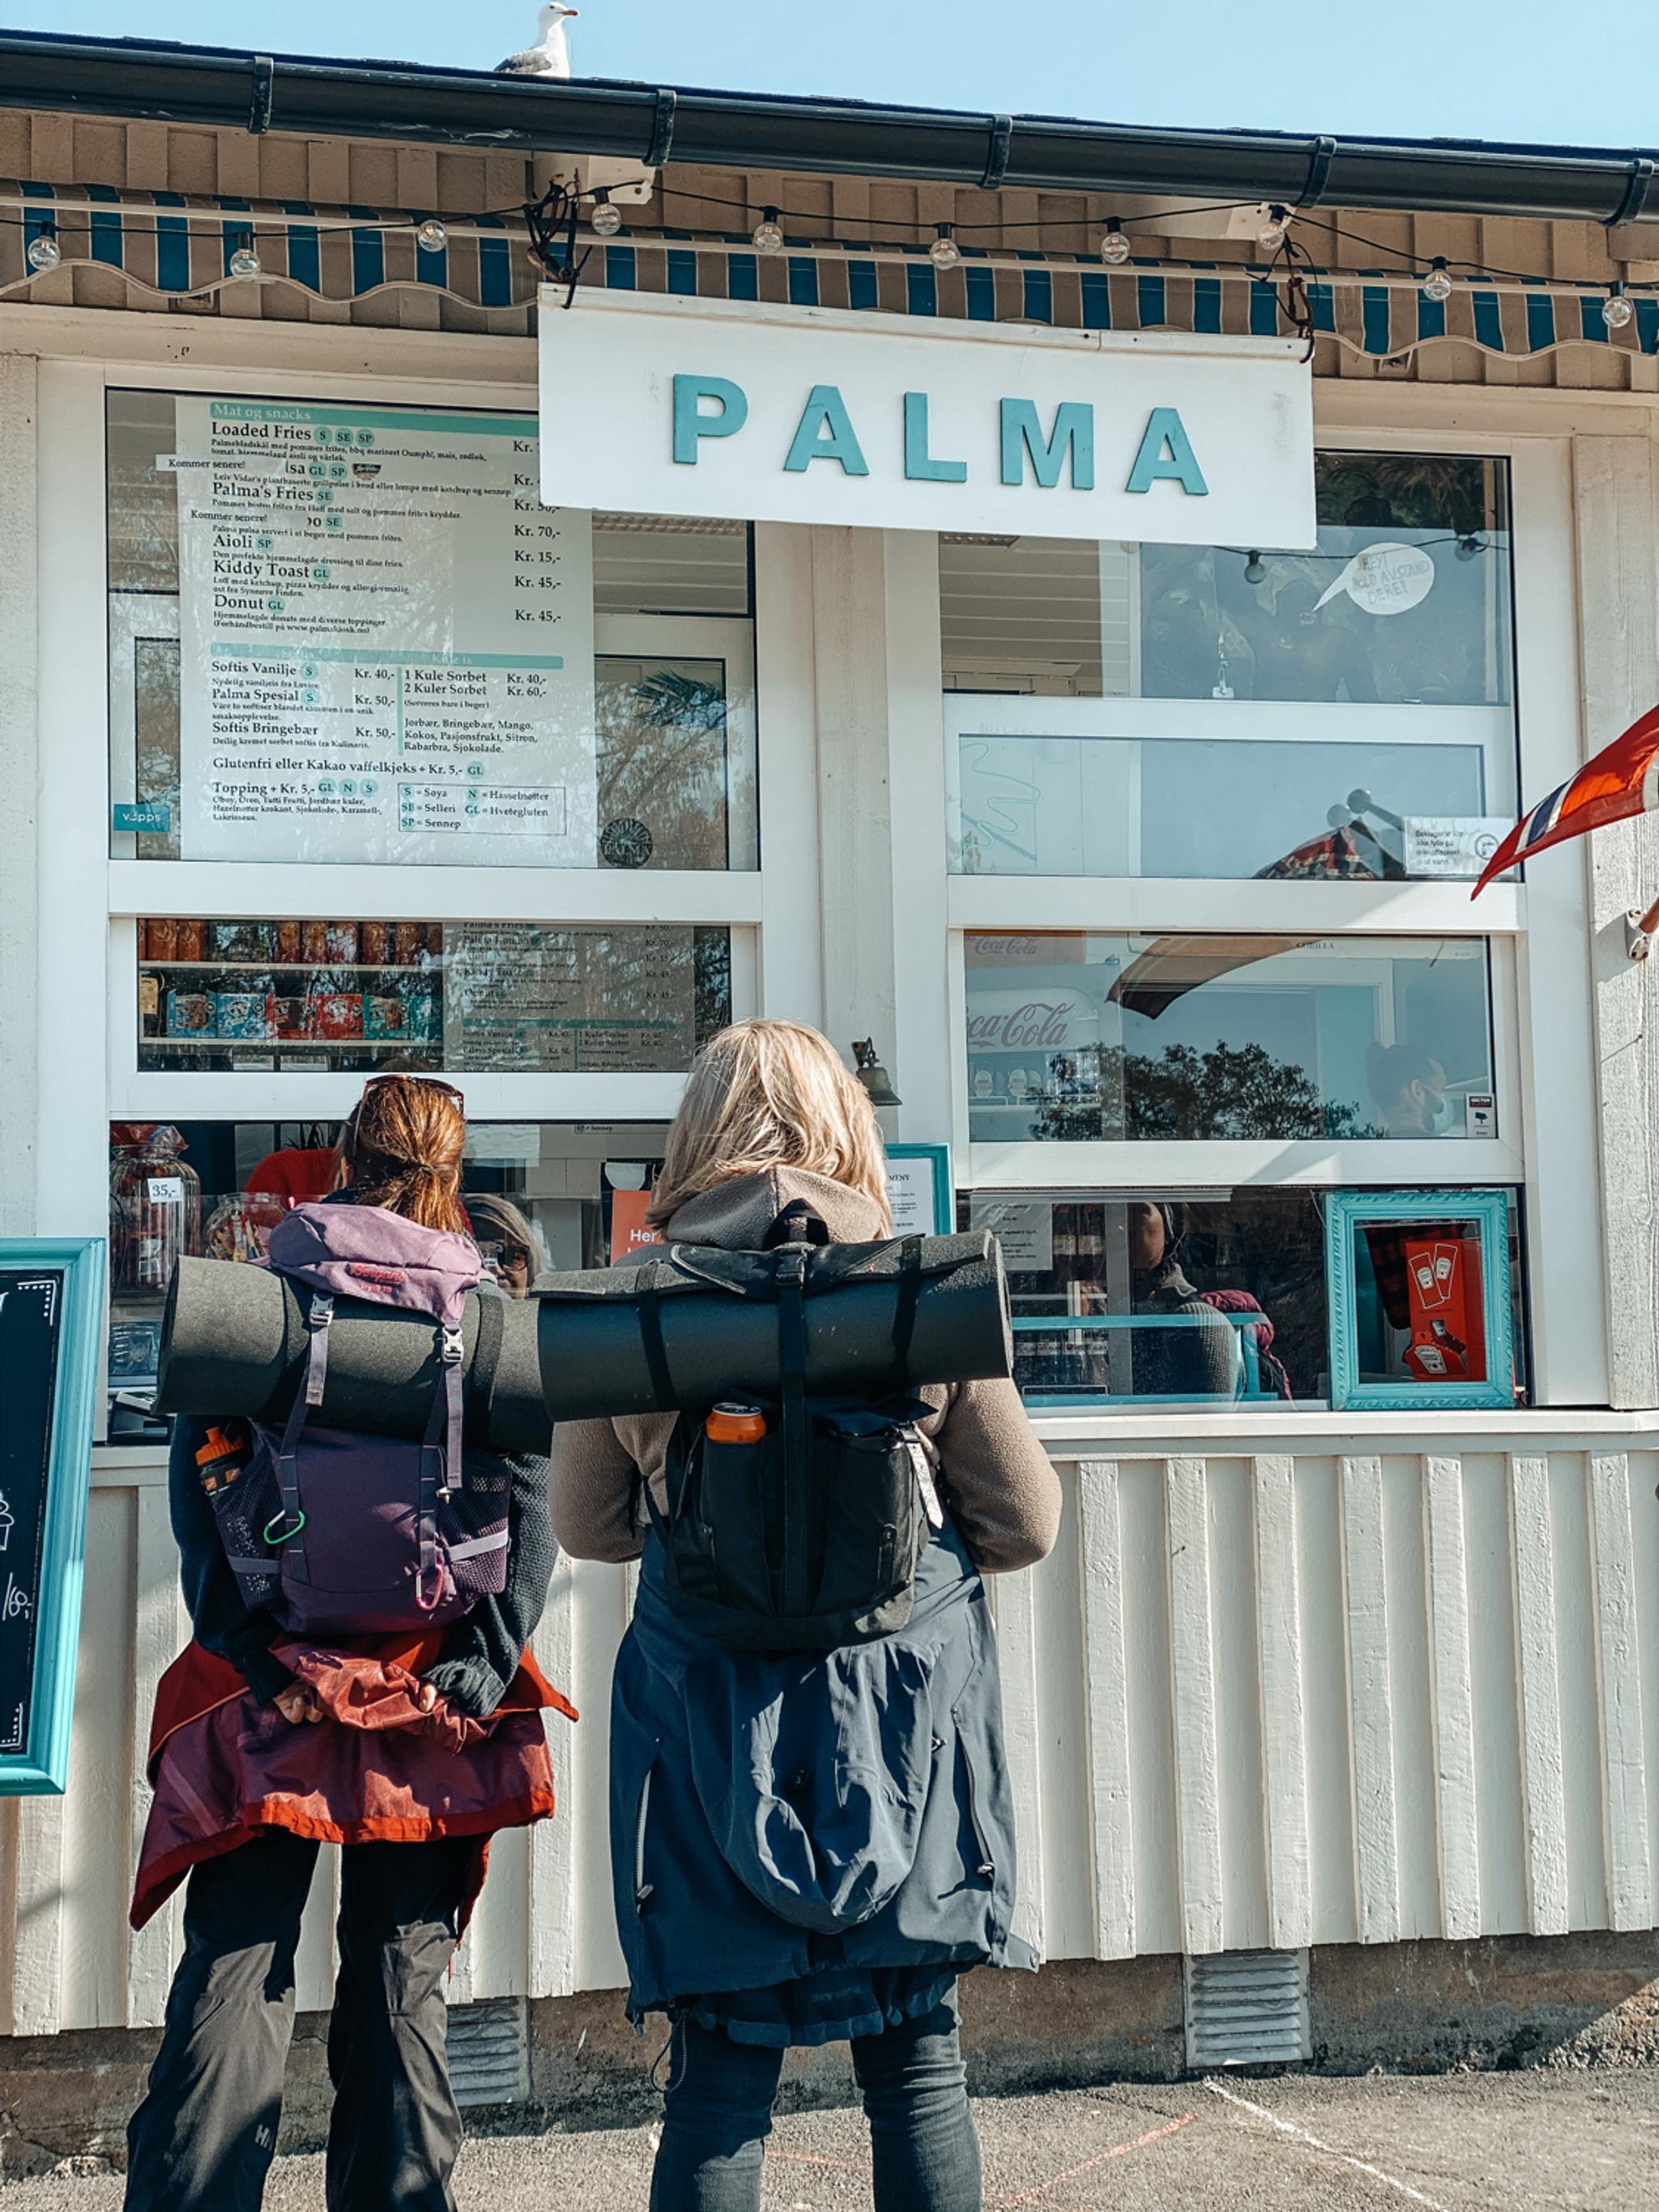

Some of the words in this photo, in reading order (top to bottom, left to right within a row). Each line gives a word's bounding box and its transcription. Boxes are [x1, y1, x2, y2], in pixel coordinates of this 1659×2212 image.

[213, 403, 241, 416] Mat
[245, 407, 262, 420] og
[266, 407, 312, 420] snacks
[211, 421, 269, 438] Loaded
[273, 424, 312, 440] Fries
[336, 433, 351, 442] SE
[357, 433, 373, 444] SP
[672, 372, 1209, 496] PALMA
[514, 440, 532, 452] Kr.
[168, 458, 211, 468] Kommer
[212, 460, 246, 469] senere!
[309, 467, 323, 476] GL
[331, 468, 345, 478] SP
[514, 474, 533, 486] Kr.
[212, 482, 272, 499] Palma's
[276, 485, 313, 501] Fries
[317, 490, 332, 501] SE
[328, 505, 344, 513] med
[514, 499, 534, 511] Kr.
[190, 509, 233, 521] Kommer
[235, 513, 267, 522] senere!
[326, 518, 339, 527] SE
[514, 525, 534, 537] Kr.
[536, 526, 561, 539] 70,-
[213, 533, 253, 548] Aioli
[258, 538, 272, 548] SP
[514, 550, 534, 562] Kr.
[537, 552, 561, 565] 15,-
[213, 559, 262, 579] Kiddy
[267, 563, 310, 578] Toast
[313, 569, 329, 578] GL
[1380, 560, 1431, 585] AVSTAND
[232, 578, 249, 586] med
[514, 575, 534, 588] Kr.
[537, 577, 561, 590] 45,-
[1367, 579, 1409, 606] DERE!
[214, 594, 264, 610] Donut
[268, 600, 284, 610] GL
[514, 609, 535, 621] Kr.
[538, 611, 562, 623] 45,-
[211, 661, 249, 674] Softis
[252, 662, 297, 677] Vanilje
[355, 668, 372, 680] Kr.
[374, 670, 395, 682] 40,-
[414, 670, 444, 682] Kule
[446, 671, 487, 683] Sorbet
[507, 673, 524, 684] Kr.
[527, 674, 547, 686] 40,-
[212, 688, 251, 700] Palma
[254, 688, 300, 703] Spesial
[404, 682, 412, 693] 2
[414, 683, 446, 694] Kuler
[449, 684, 487, 697] Sorbet
[507, 685, 524, 697] Kr.
[527, 687, 547, 698] 60,-
[355, 694, 372, 706] Kr.
[374, 696, 395, 708] 50,-
[212, 721, 249, 734] Softis
[252, 722, 318, 737] Bringebær
[442, 718, 496, 731] Bringebær,
[498, 720, 534, 732] Mango,
[356, 727, 373, 738] Kr.
[376, 728, 396, 740] 50,-
[404, 730, 438, 741] Kokos,
[440, 731, 503, 744] Pasjonsfrukt,
[505, 732, 538, 744] Sitron,
[403, 742, 451, 753] Rabarbra,
[453, 743, 504, 754] Sjokolade.
[212, 757, 272, 770] Glutenfri
[275, 759, 304, 770] eller
[306, 759, 347, 772] Kakao
[349, 760, 417, 775] vaffelkjeks
[428, 764, 446, 775] Kr.
[449, 765, 463, 777] 5,-
[467, 766, 484, 776] GL
[212, 782, 268, 796] Topping
[279, 783, 298, 795] Kr.
[301, 785, 316, 796] 5,-
[318, 782, 335, 792] GL
[343, 783, 352, 792] N
[423, 788, 448, 799] Soya
[424, 803, 456, 813] Selleri
[464, 805, 480, 815] GL
[489, 806, 548, 818] Hvetegluten
[401, 817, 416, 828] SP
[424, 819, 462, 831] Sennep
[151, 1184, 177, 1198] 35,-
